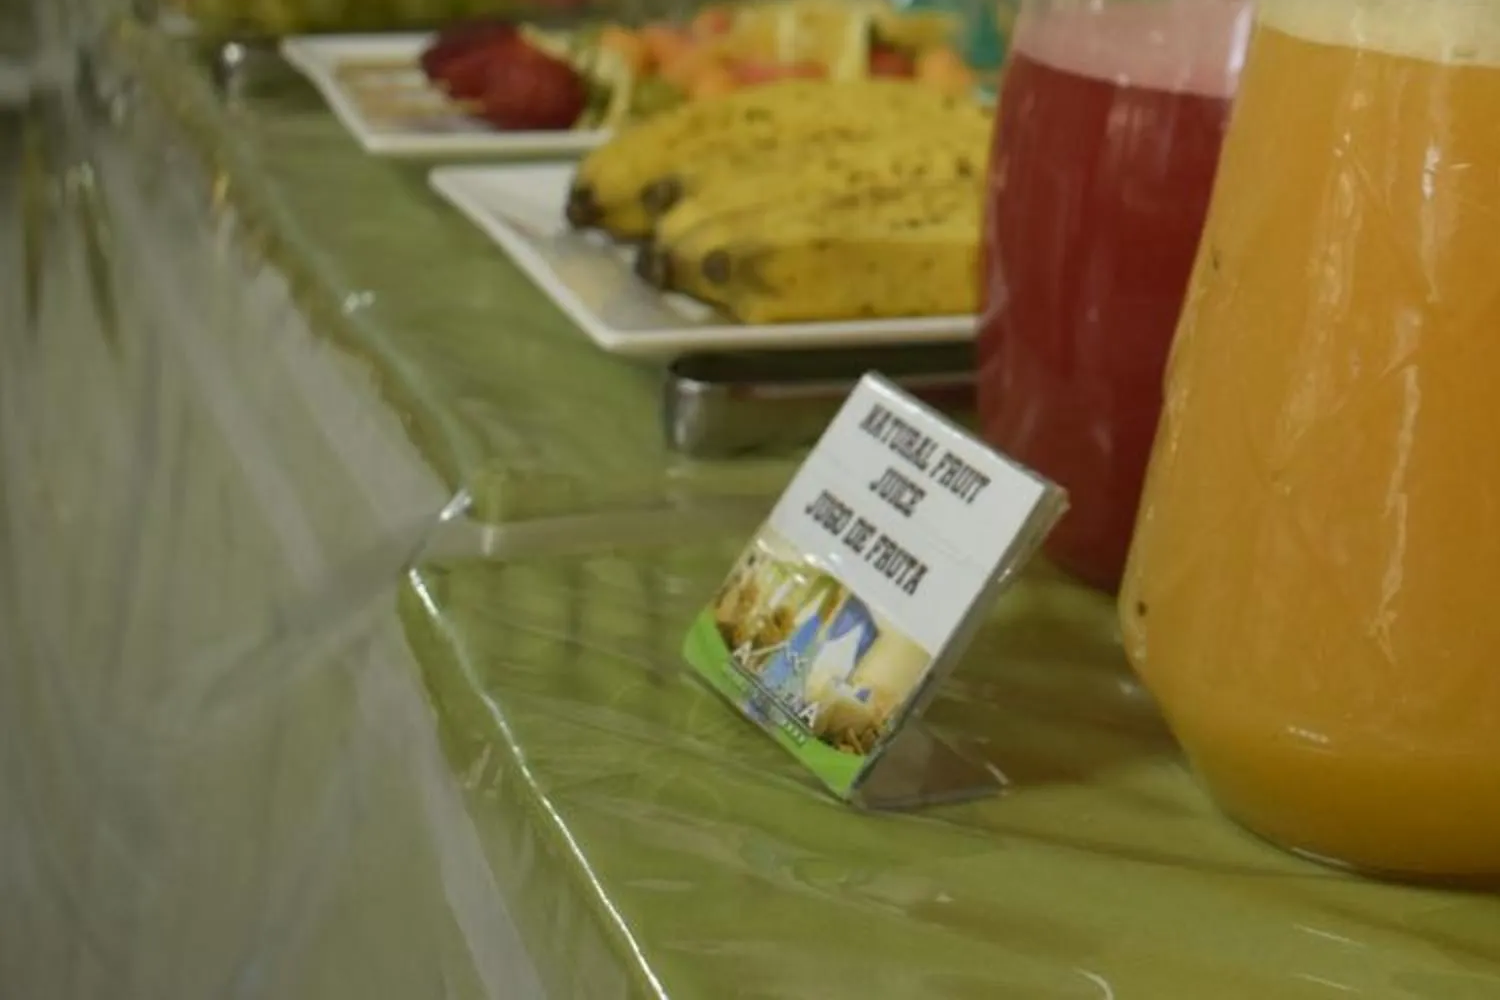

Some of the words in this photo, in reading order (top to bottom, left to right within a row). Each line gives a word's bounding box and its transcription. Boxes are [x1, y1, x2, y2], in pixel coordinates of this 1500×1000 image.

[859, 403, 938, 470] NATURAL
[929, 450, 991, 504] FRUIT
[869, 466, 926, 517] JUICE
[804, 489, 854, 536] JUGO
[842, 516, 876, 556] DE
[864, 533, 928, 596] FRUTA
